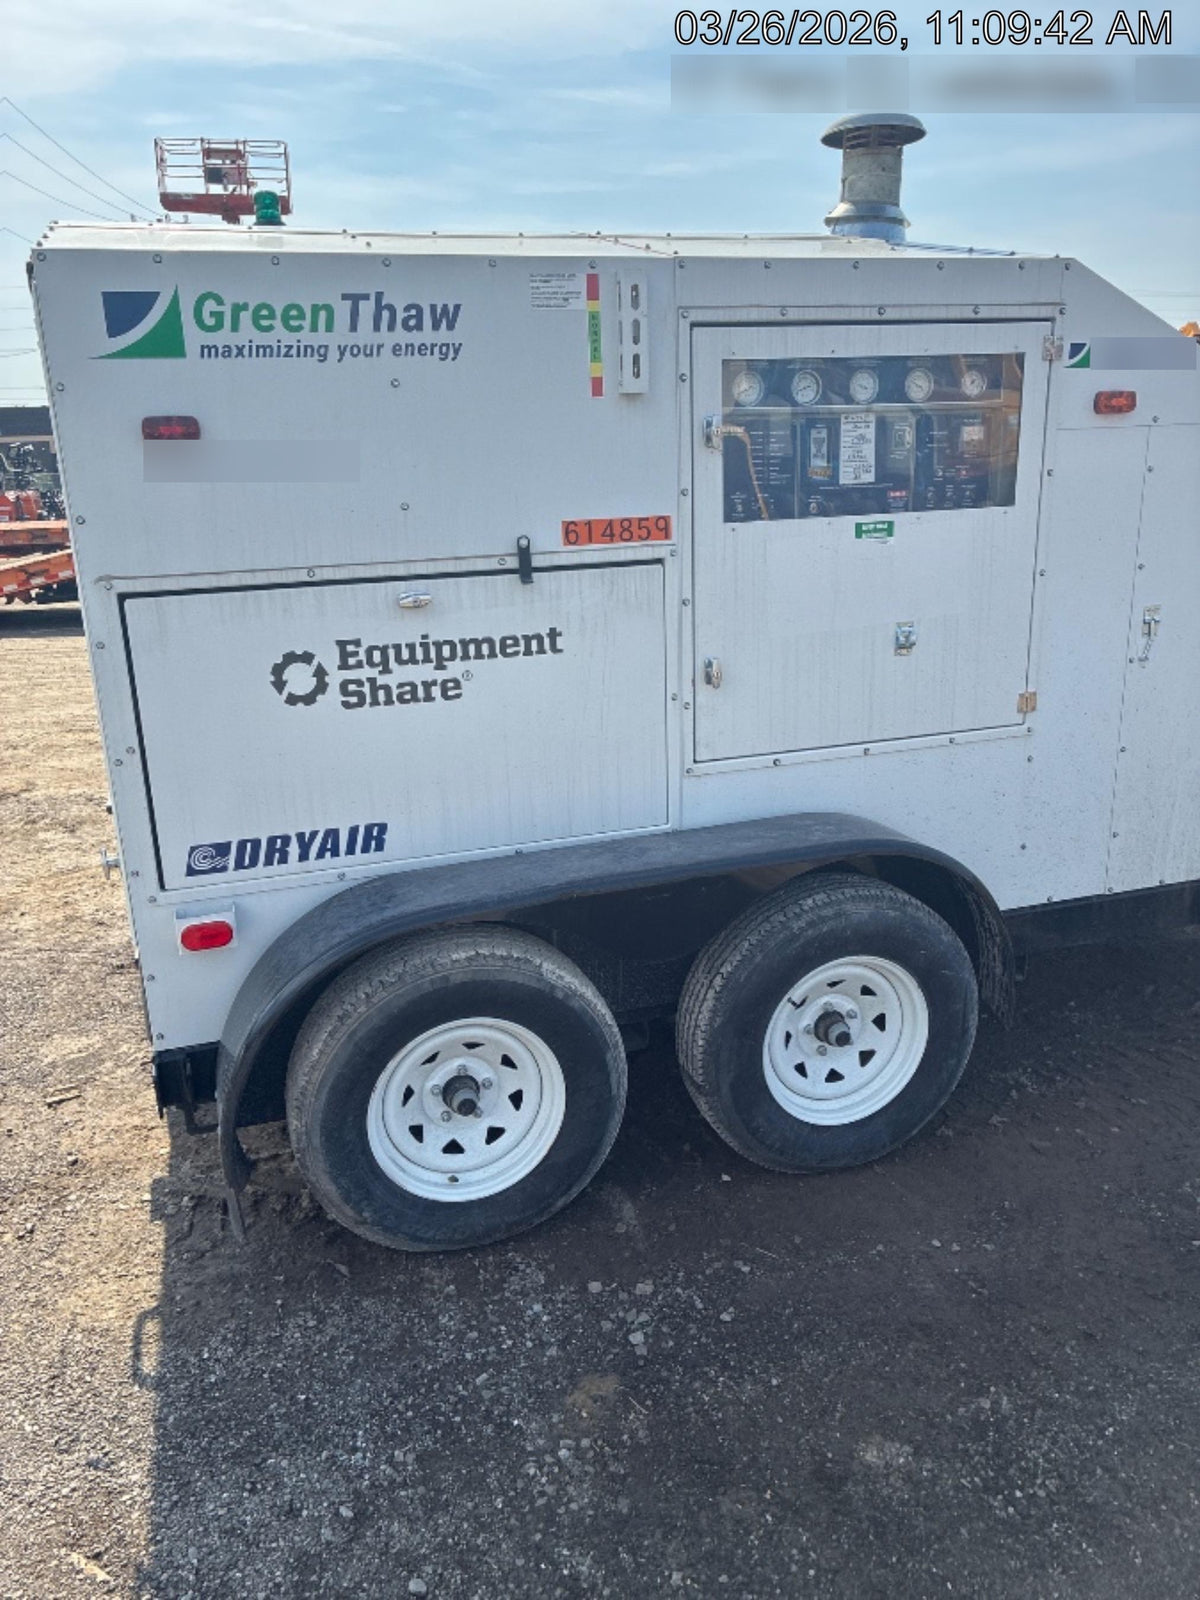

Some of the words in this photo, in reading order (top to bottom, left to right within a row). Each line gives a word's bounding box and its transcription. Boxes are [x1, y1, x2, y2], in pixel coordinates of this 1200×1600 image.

[200, 339, 330, 362] maximizing
[337, 342, 384, 363] your
[391, 339, 463, 362] energy
[565, 516, 670, 545] 614859
[335, 626, 564, 675] Equipment
[232, 822, 389, 872] DRYAIR
